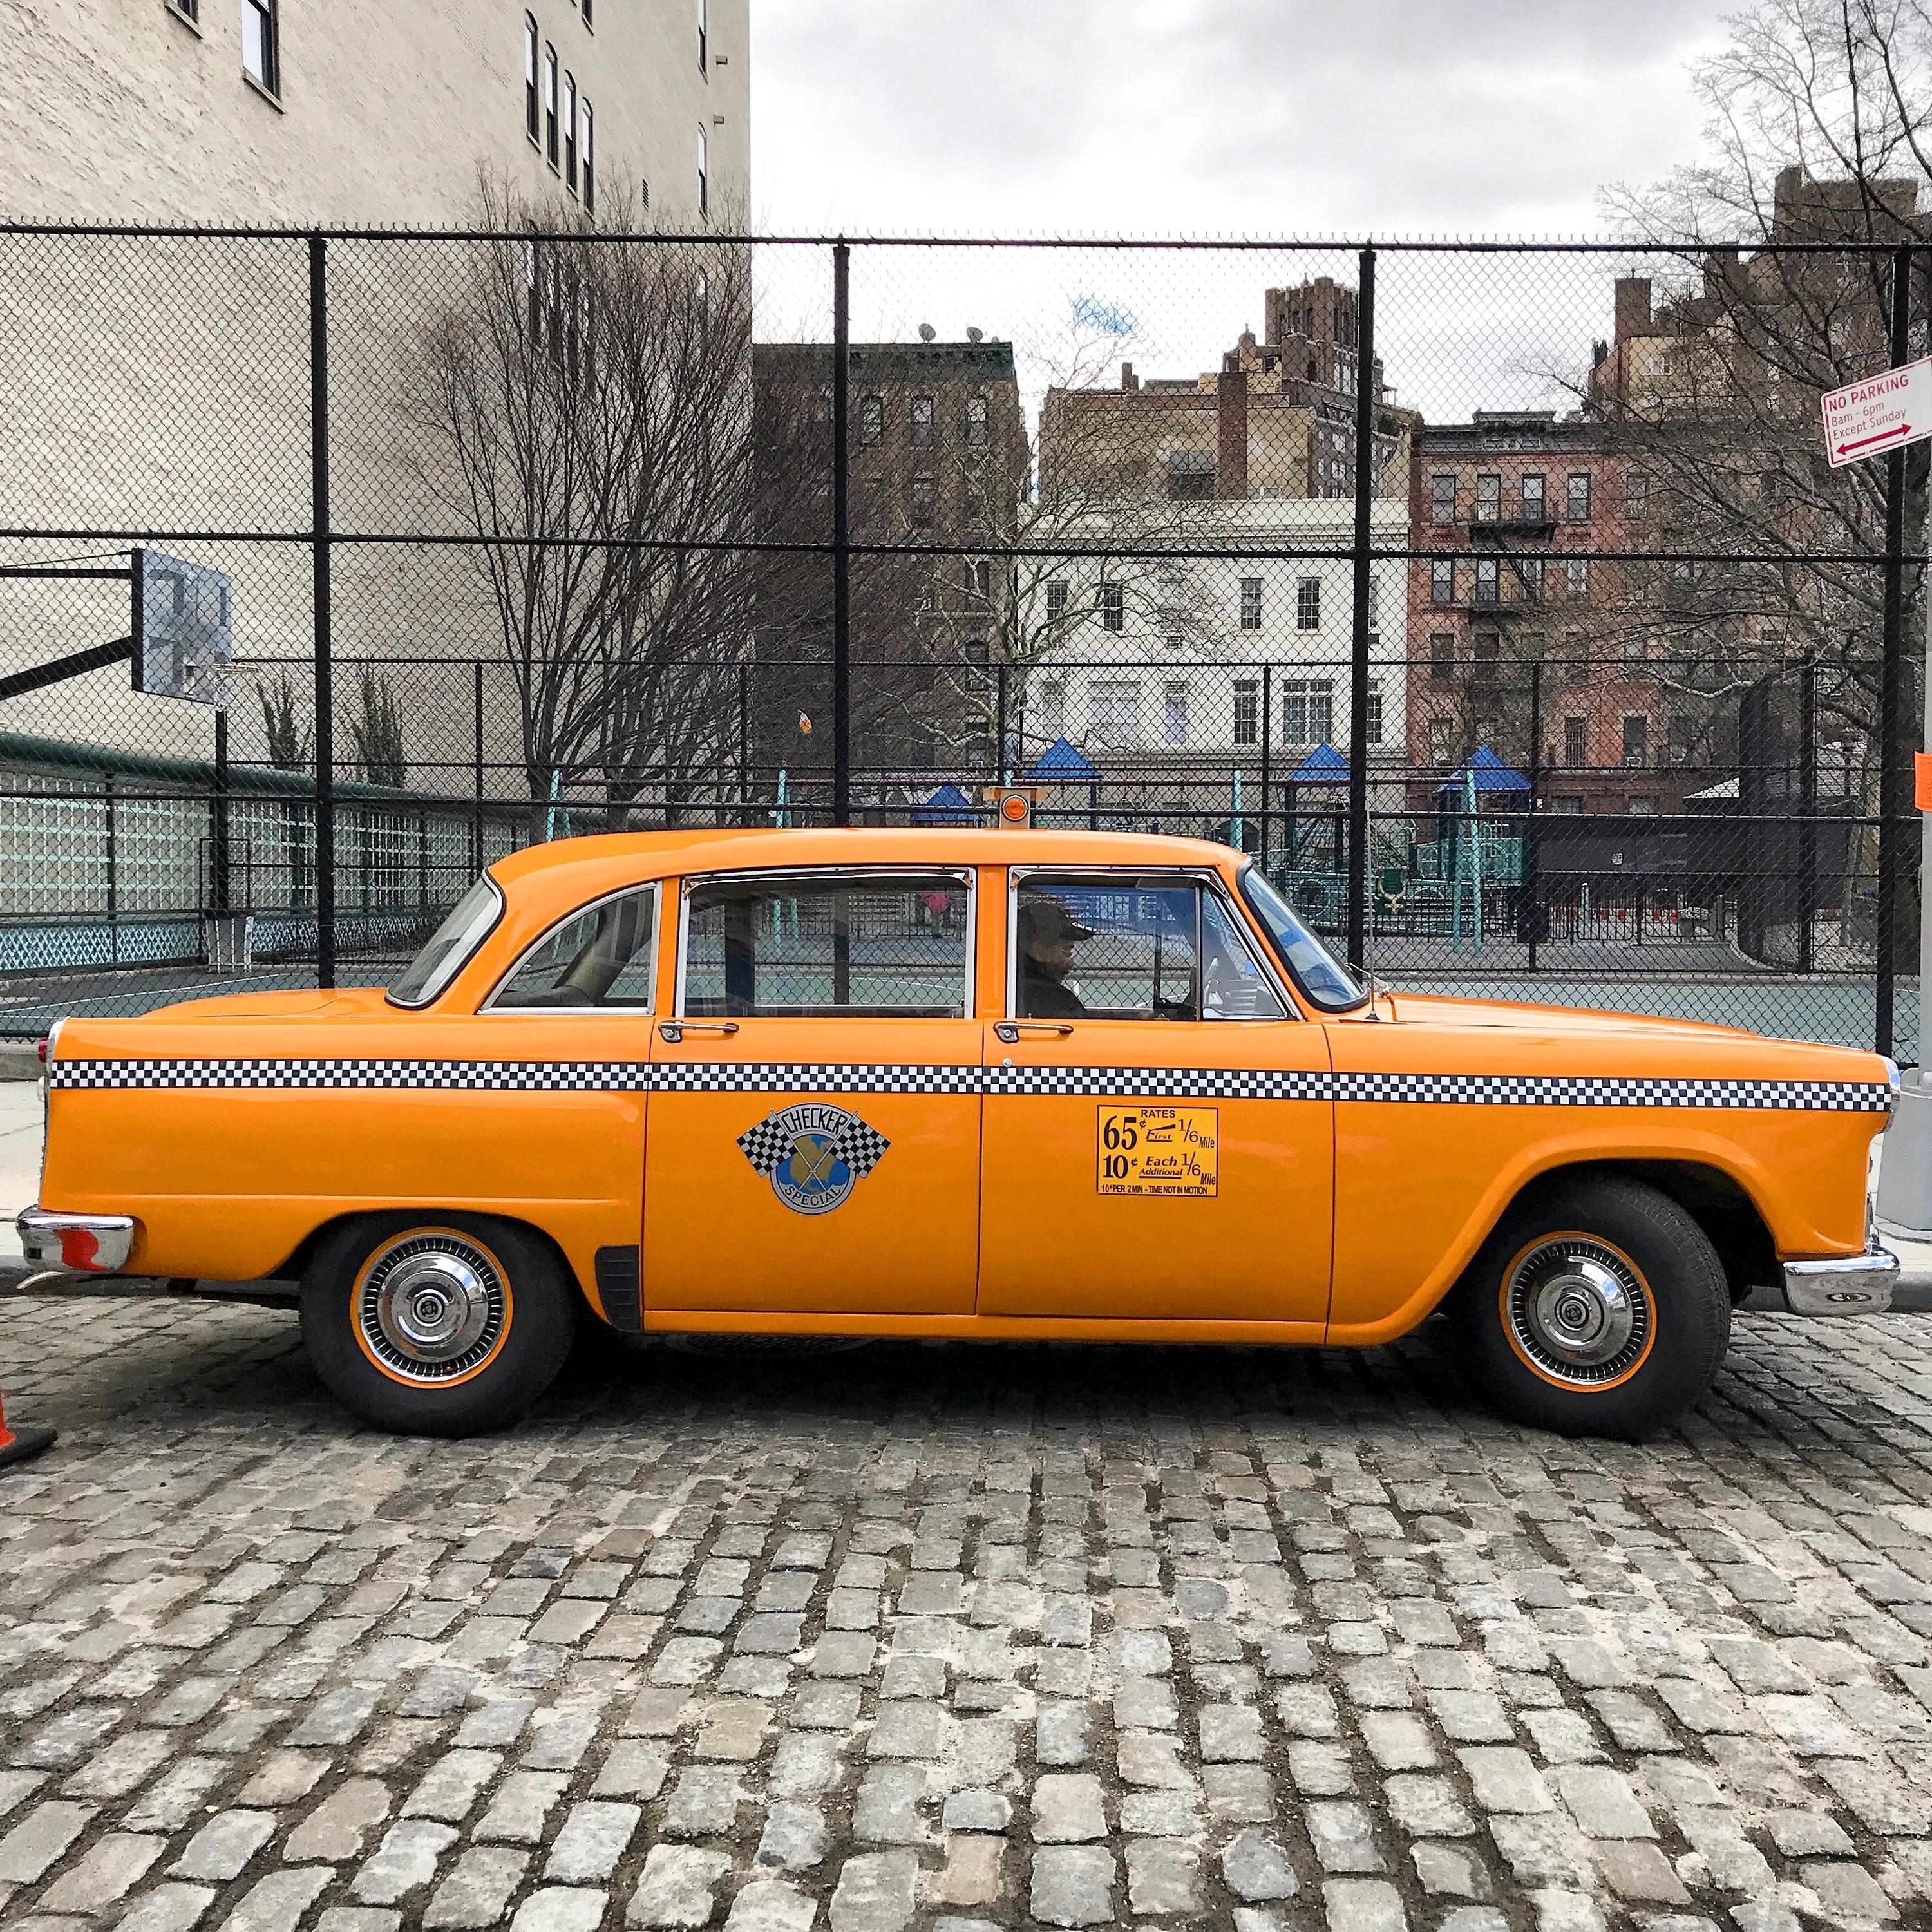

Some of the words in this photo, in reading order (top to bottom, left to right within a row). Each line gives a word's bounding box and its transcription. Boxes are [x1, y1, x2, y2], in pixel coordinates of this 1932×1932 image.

[1829, 395, 1846, 412] NO
[1851, 374, 1909, 404] PARKING
[1832, 413, 1853, 427] 8am
[1863, 402, 1885, 417] 6pm
[1833, 421, 1866, 440] Except
[1870, 408, 1906, 428] Sunday
[781, 1107, 848, 1135] CHECKER
[1141, 1109, 1175, 1119] RATES
[1145, 1124, 1175, 1139] First
[1178, 1119, 1198, 1143] 1/6
[1199, 1137, 1215, 1149] Mile
[1139, 1168, 1184, 1176] Additional
[1146, 1156, 1178, 1166] Each
[1181, 1151, 1201, 1176] 1/6
[1200, 1173, 1216, 1185] Mile
[784, 1186, 841, 1206] SPECIAL
[1148, 1185, 1162, 1193] TIME
[1184, 1186, 1208, 1195] MOTION
